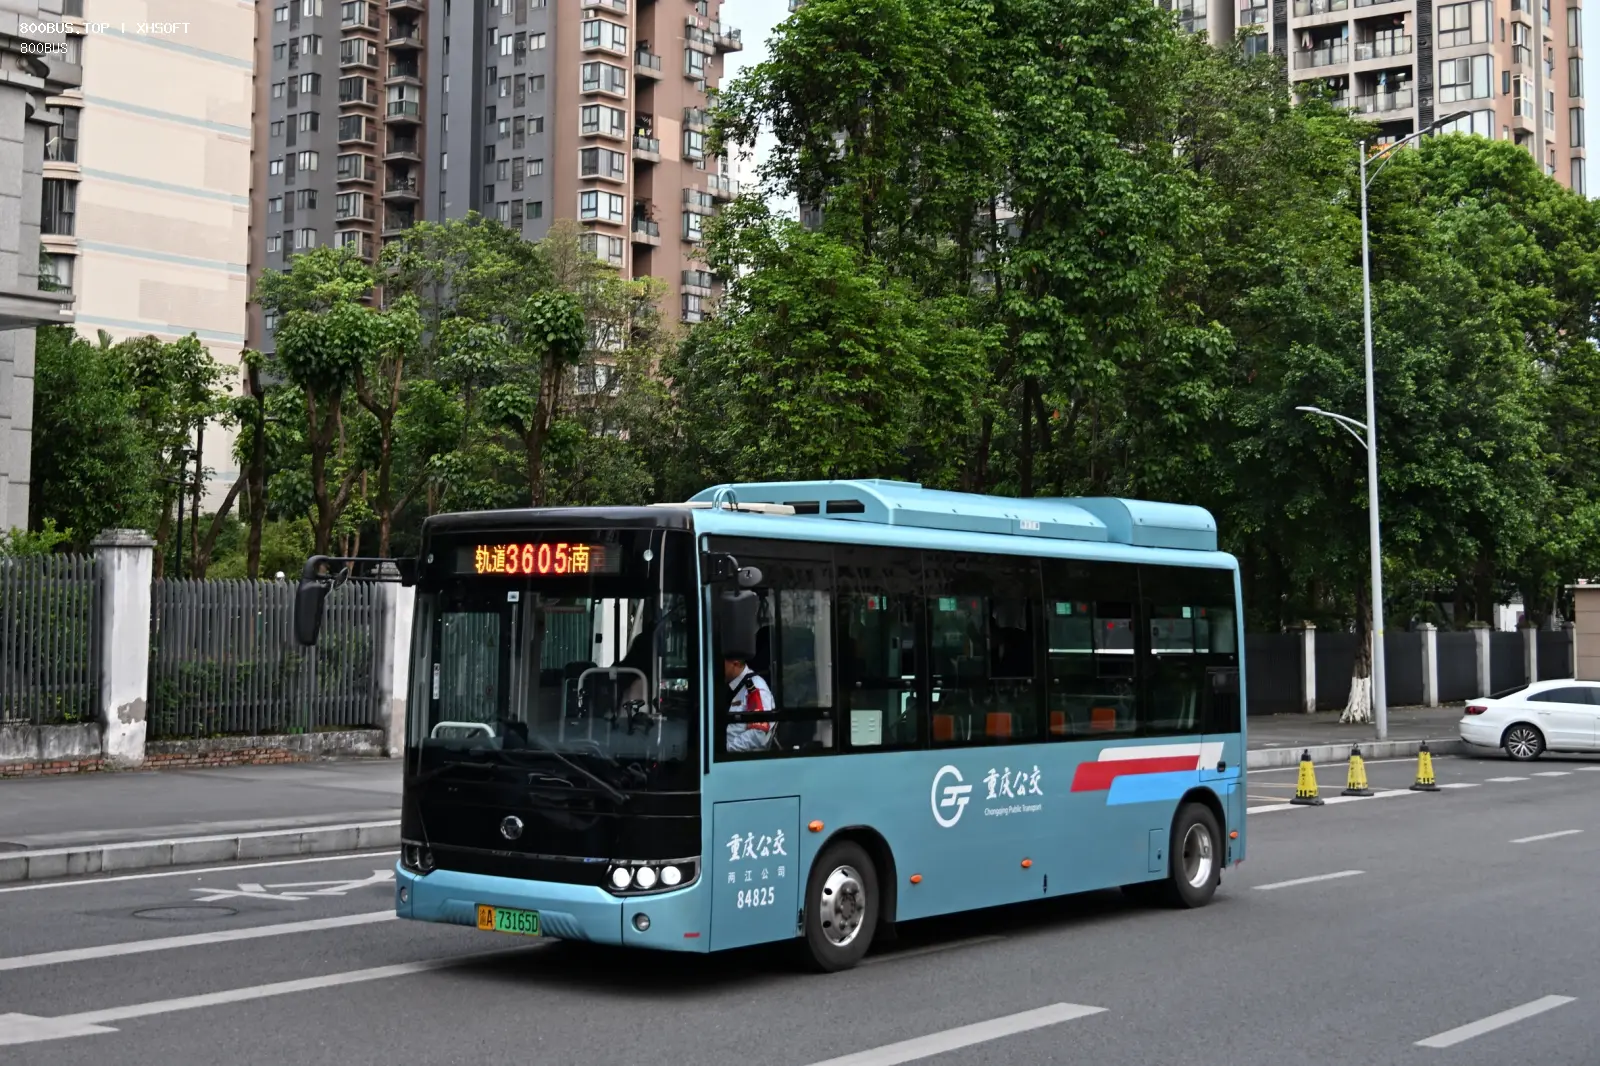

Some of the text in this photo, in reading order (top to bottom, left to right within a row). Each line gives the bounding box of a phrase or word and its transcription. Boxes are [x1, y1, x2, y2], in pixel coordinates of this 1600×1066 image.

[982, 765, 1043, 800] 重庆公交
[726, 829, 787, 861] 重庆公交
[728, 866, 785, 883] 两江公司
[737, 886, 775, 909] 84825
